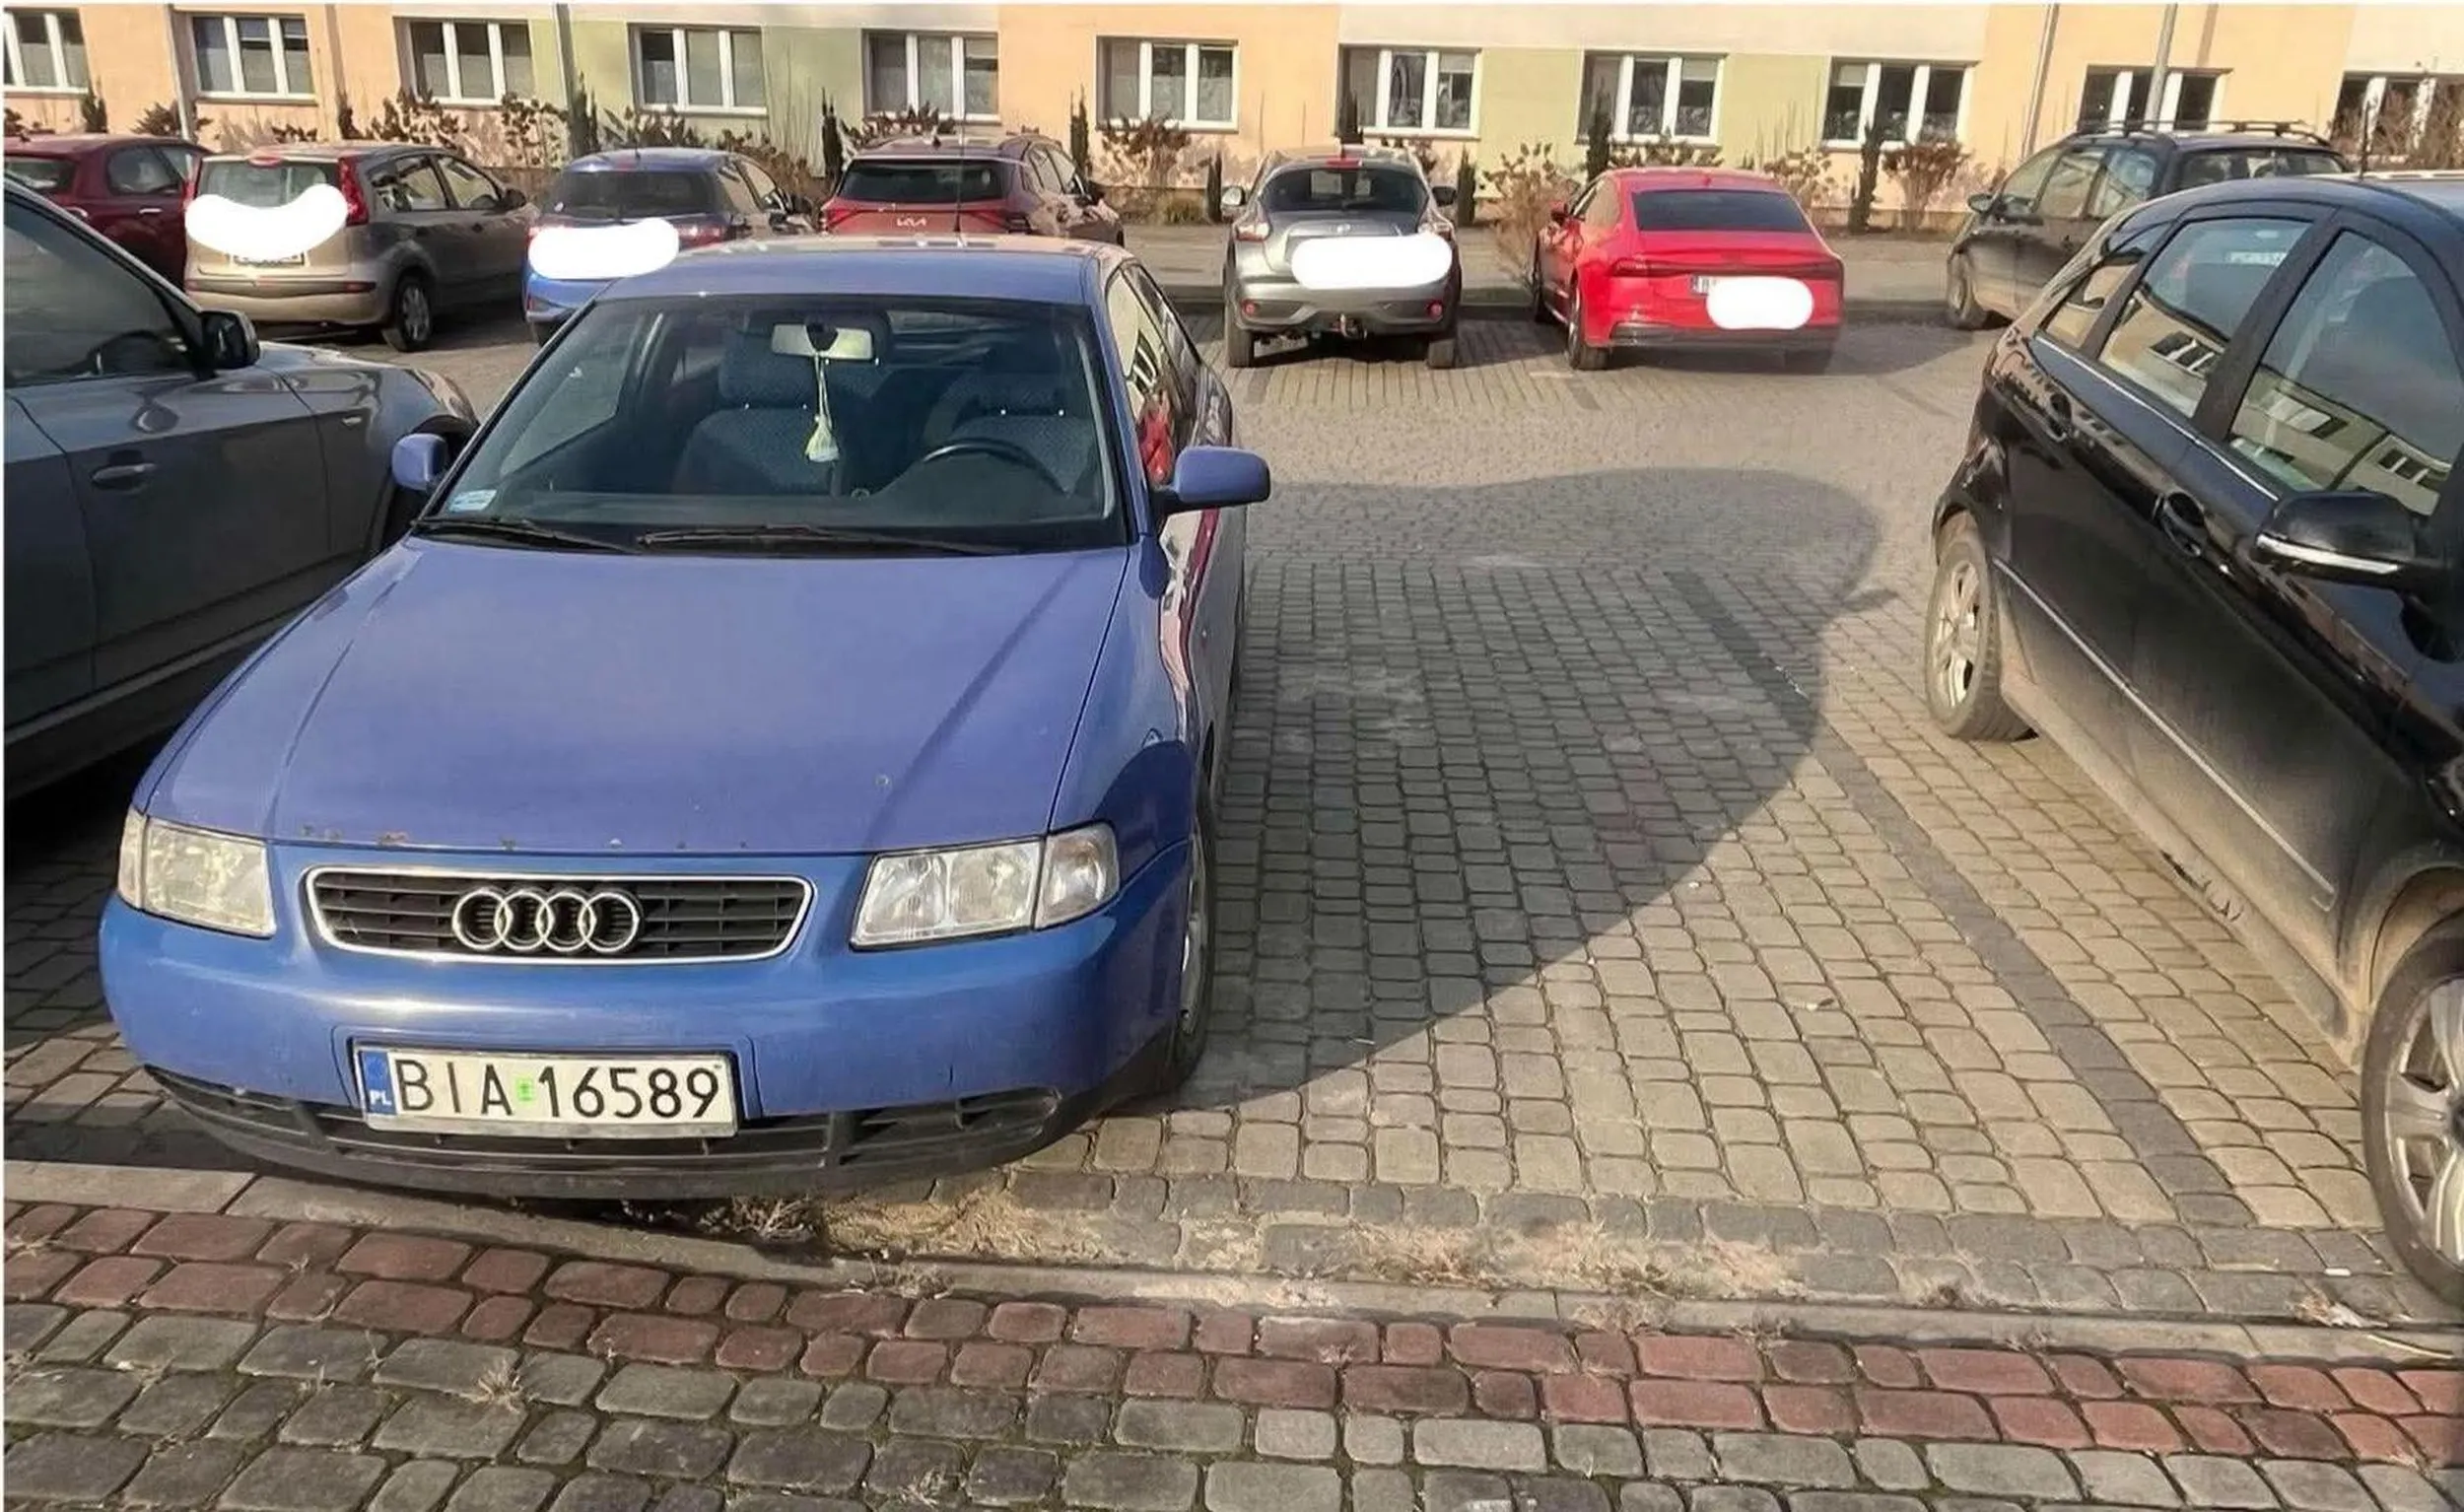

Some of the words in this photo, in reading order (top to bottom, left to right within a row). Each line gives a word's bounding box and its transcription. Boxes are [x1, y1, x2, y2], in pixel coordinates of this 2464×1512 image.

[370, 1088, 393, 1105] PL
[394, 1059, 513, 1117] BIA
[538, 1065, 719, 1119] 16589
